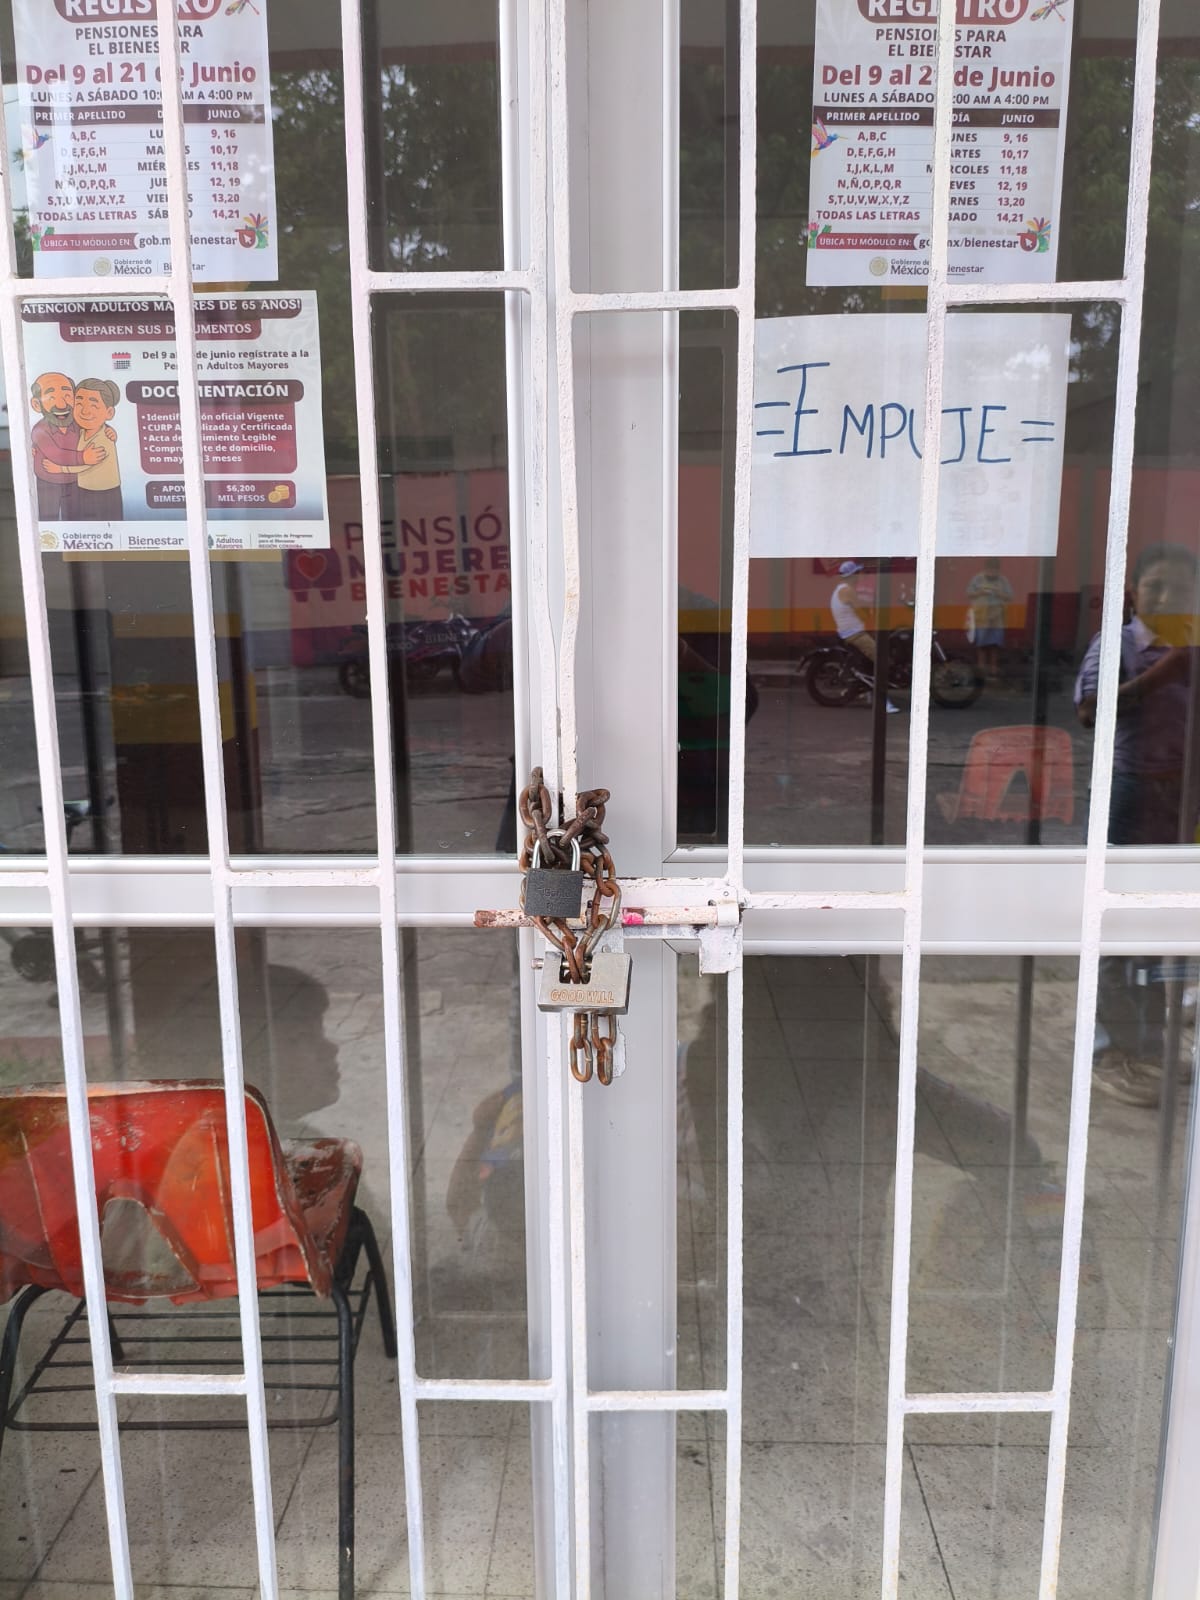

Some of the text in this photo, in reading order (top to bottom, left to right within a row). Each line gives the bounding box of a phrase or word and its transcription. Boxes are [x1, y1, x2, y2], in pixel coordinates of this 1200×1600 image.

[66, 0, 217, 16] REGISRO
[868, 0, 1021, 18] REGITRO
[75, 25, 158, 40] PENSIONES
[875, 28, 1007, 42] PENSIOS PARA
[88, 41, 190, 55] EL BIENESR
[888, 44, 992, 58] EL BIESTAR
[26, 63, 66, 85] Del
[72, 64, 86, 85] 9
[92, 62, 113, 84] al
[119, 62, 146, 83] 21
[189, 61, 256, 88] Junio
[822, 64, 861, 85] Del
[868, 65, 882, 85] 9
[889, 63, 912, 85] al
[953, 65, 984, 86] de
[987, 65, 1055, 92] Junio
[75, 91, 85, 103] A
[87, 87, 138, 102] SÁBADO
[197, 91, 206, 101] A
[208, 89, 233, 101] 4:00
[236, 91, 253, 101] PM
[824, 89, 1049, 105] LUNES A SÁBADO AM A 4:00 PM
[35, 110, 126, 121] PRIMER APELLIDO
[207, 109, 241, 121] JUNIO
[826, 111, 920, 121] PRIMER APELLIDO
[952, 111, 971, 123] DÍA
[1001, 114, 1035, 125] JUNIO
[71, 130, 97, 142] A,B,C
[857, 131, 887, 142] A,B,C
[951, 133, 978, 143] UNES
[210, 145, 239, 156] 10,17
[846, 147, 896, 158] D,E,F,G,H
[1000, 149, 1029, 160] 10,17
[137, 160, 201, 171] MIÉRES
[210, 161, 239, 172] 11,18
[846, 163, 895, 175] I,J,K,L,M
[999, 165, 1028, 176] 11,18
[837, 177, 902, 190] N,Ñ,O,P,Q,R
[949, 180, 976, 190] EVES
[146, 193, 194, 203] VIES
[211, 193, 240, 204] 13,20
[827, 194, 910, 206] S,T,U,V,W,X,Y,Z
[950, 196, 979, 206] RNES
[997, 197, 1025, 207] 13,20
[36, 210, 138, 222] TODAS LAS LETRAS
[212, 209, 240, 220] 14,21
[816, 209, 921, 221] TODAS LAS LETRAS
[996, 213, 1024, 222] 14,21
[43, 239, 69, 248] UBICA
[70, 239, 81, 247] TU
[82, 237, 118, 247] MÓDULO
[819, 238, 845, 246] UBICA
[846, 238, 857, 246] TU
[859, 237, 897, 246] MÓDULO
[113, 264, 152, 275] México
[163, 262, 206, 271] Bitar
[890, 264, 930, 275] México
[90, 301, 150, 312] ADULTOS
[153, 300, 216, 312] MARES
[219, 300, 238, 310] DE
[241, 299, 256, 310] 65
[70, 323, 252, 336] PREPAREN SUS DUMENTOS
[142, 351, 159, 359] Del
[161, 351, 168, 359] 9
[196, 350, 208, 359] de
[210, 350, 236, 361] junio
[299, 349, 309, 358] la
[206, 361, 245, 370] Adultos
[247, 361, 290, 371] Mayores
[141, 382, 289, 398] DOCENTACIÓN
[215, 412, 245, 421] oficial
[247, 412, 285, 423] Vigente
[147, 423, 173, 432] CURP
[232, 424, 239, 433] y
[240, 422, 293, 431] Certificada
[149, 433, 170, 442] Acta
[242, 433, 277, 444] Legible
[216, 444, 227, 452] de
[211, 455, 242, 463] meses
[226, 484, 256, 493] $6,200
[217, 494, 266, 502] MIL PESOS
[62, 532, 185, 546] Gobierno de Bienestar
[63, 538, 114, 550] México
